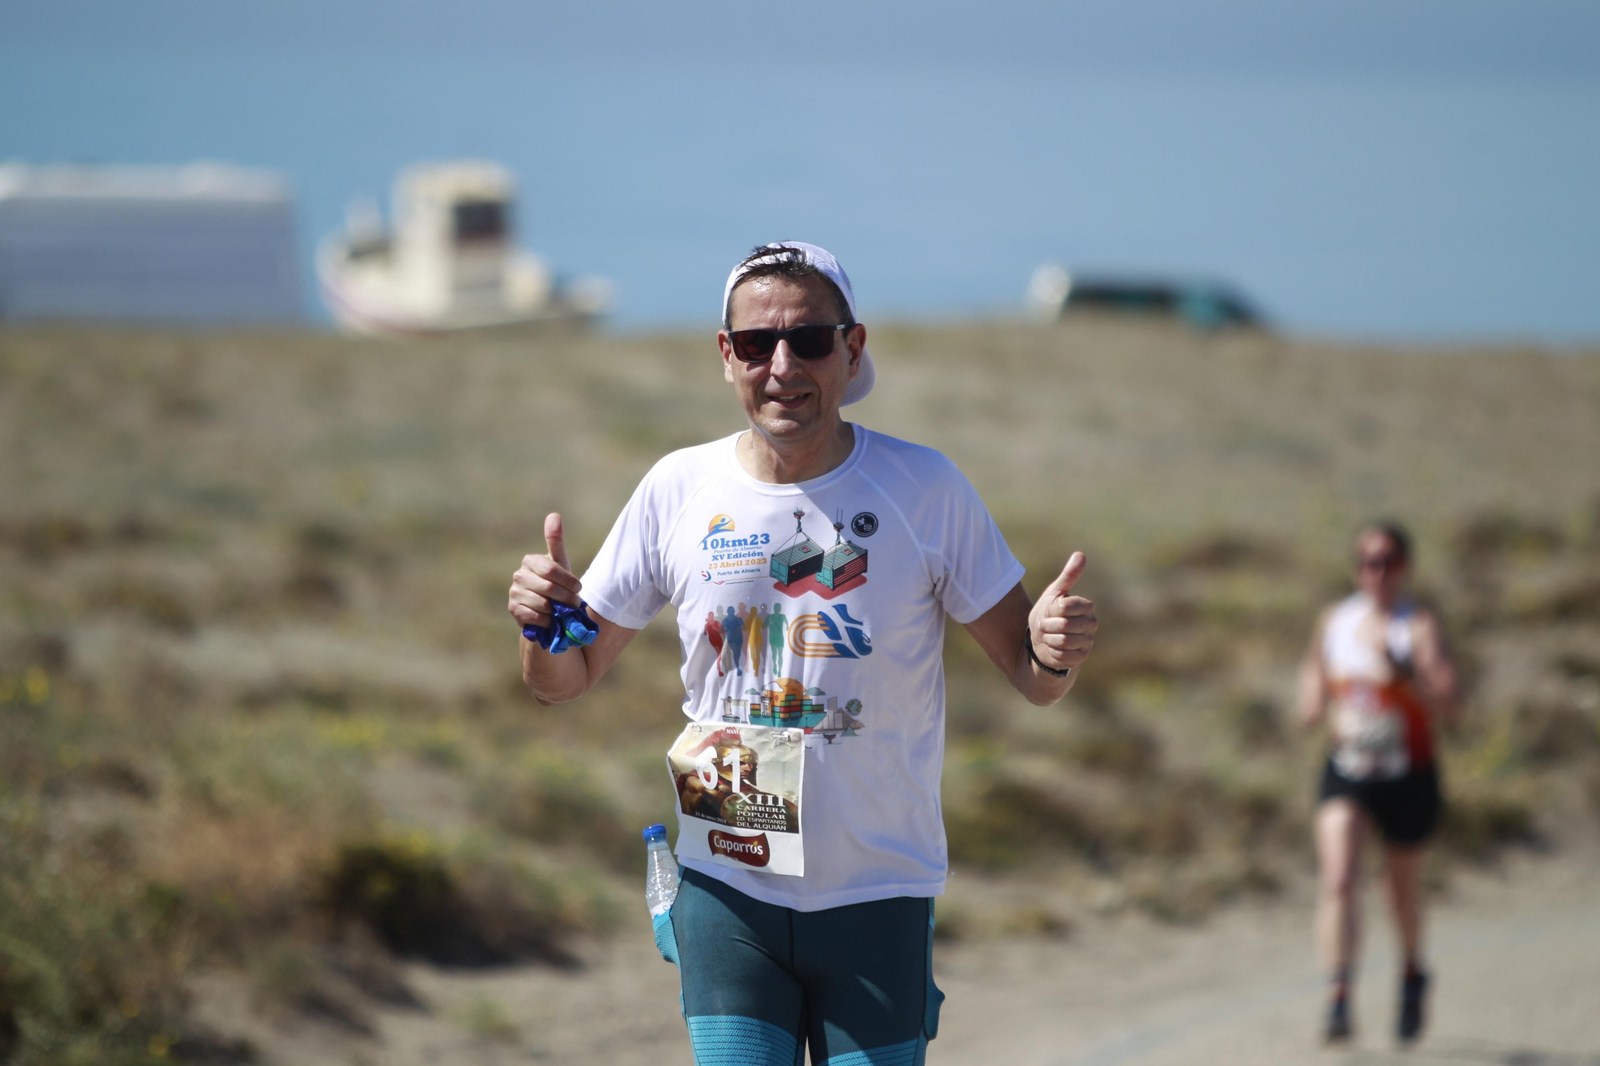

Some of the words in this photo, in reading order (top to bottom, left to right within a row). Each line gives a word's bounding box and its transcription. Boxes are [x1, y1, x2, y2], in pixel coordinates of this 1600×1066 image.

[702, 533, 770, 550] 10km23
[727, 551, 764, 560] Edición
[720, 560, 743, 569] Abril
[745, 558, 768, 566] 2023
[696, 746, 740, 793] 61
[736, 792, 786, 808] XIII
[736, 805, 787, 814] CARRERA
[736, 811, 786, 820] POPULAR
[747, 817, 787, 826] ESPARTANOS
